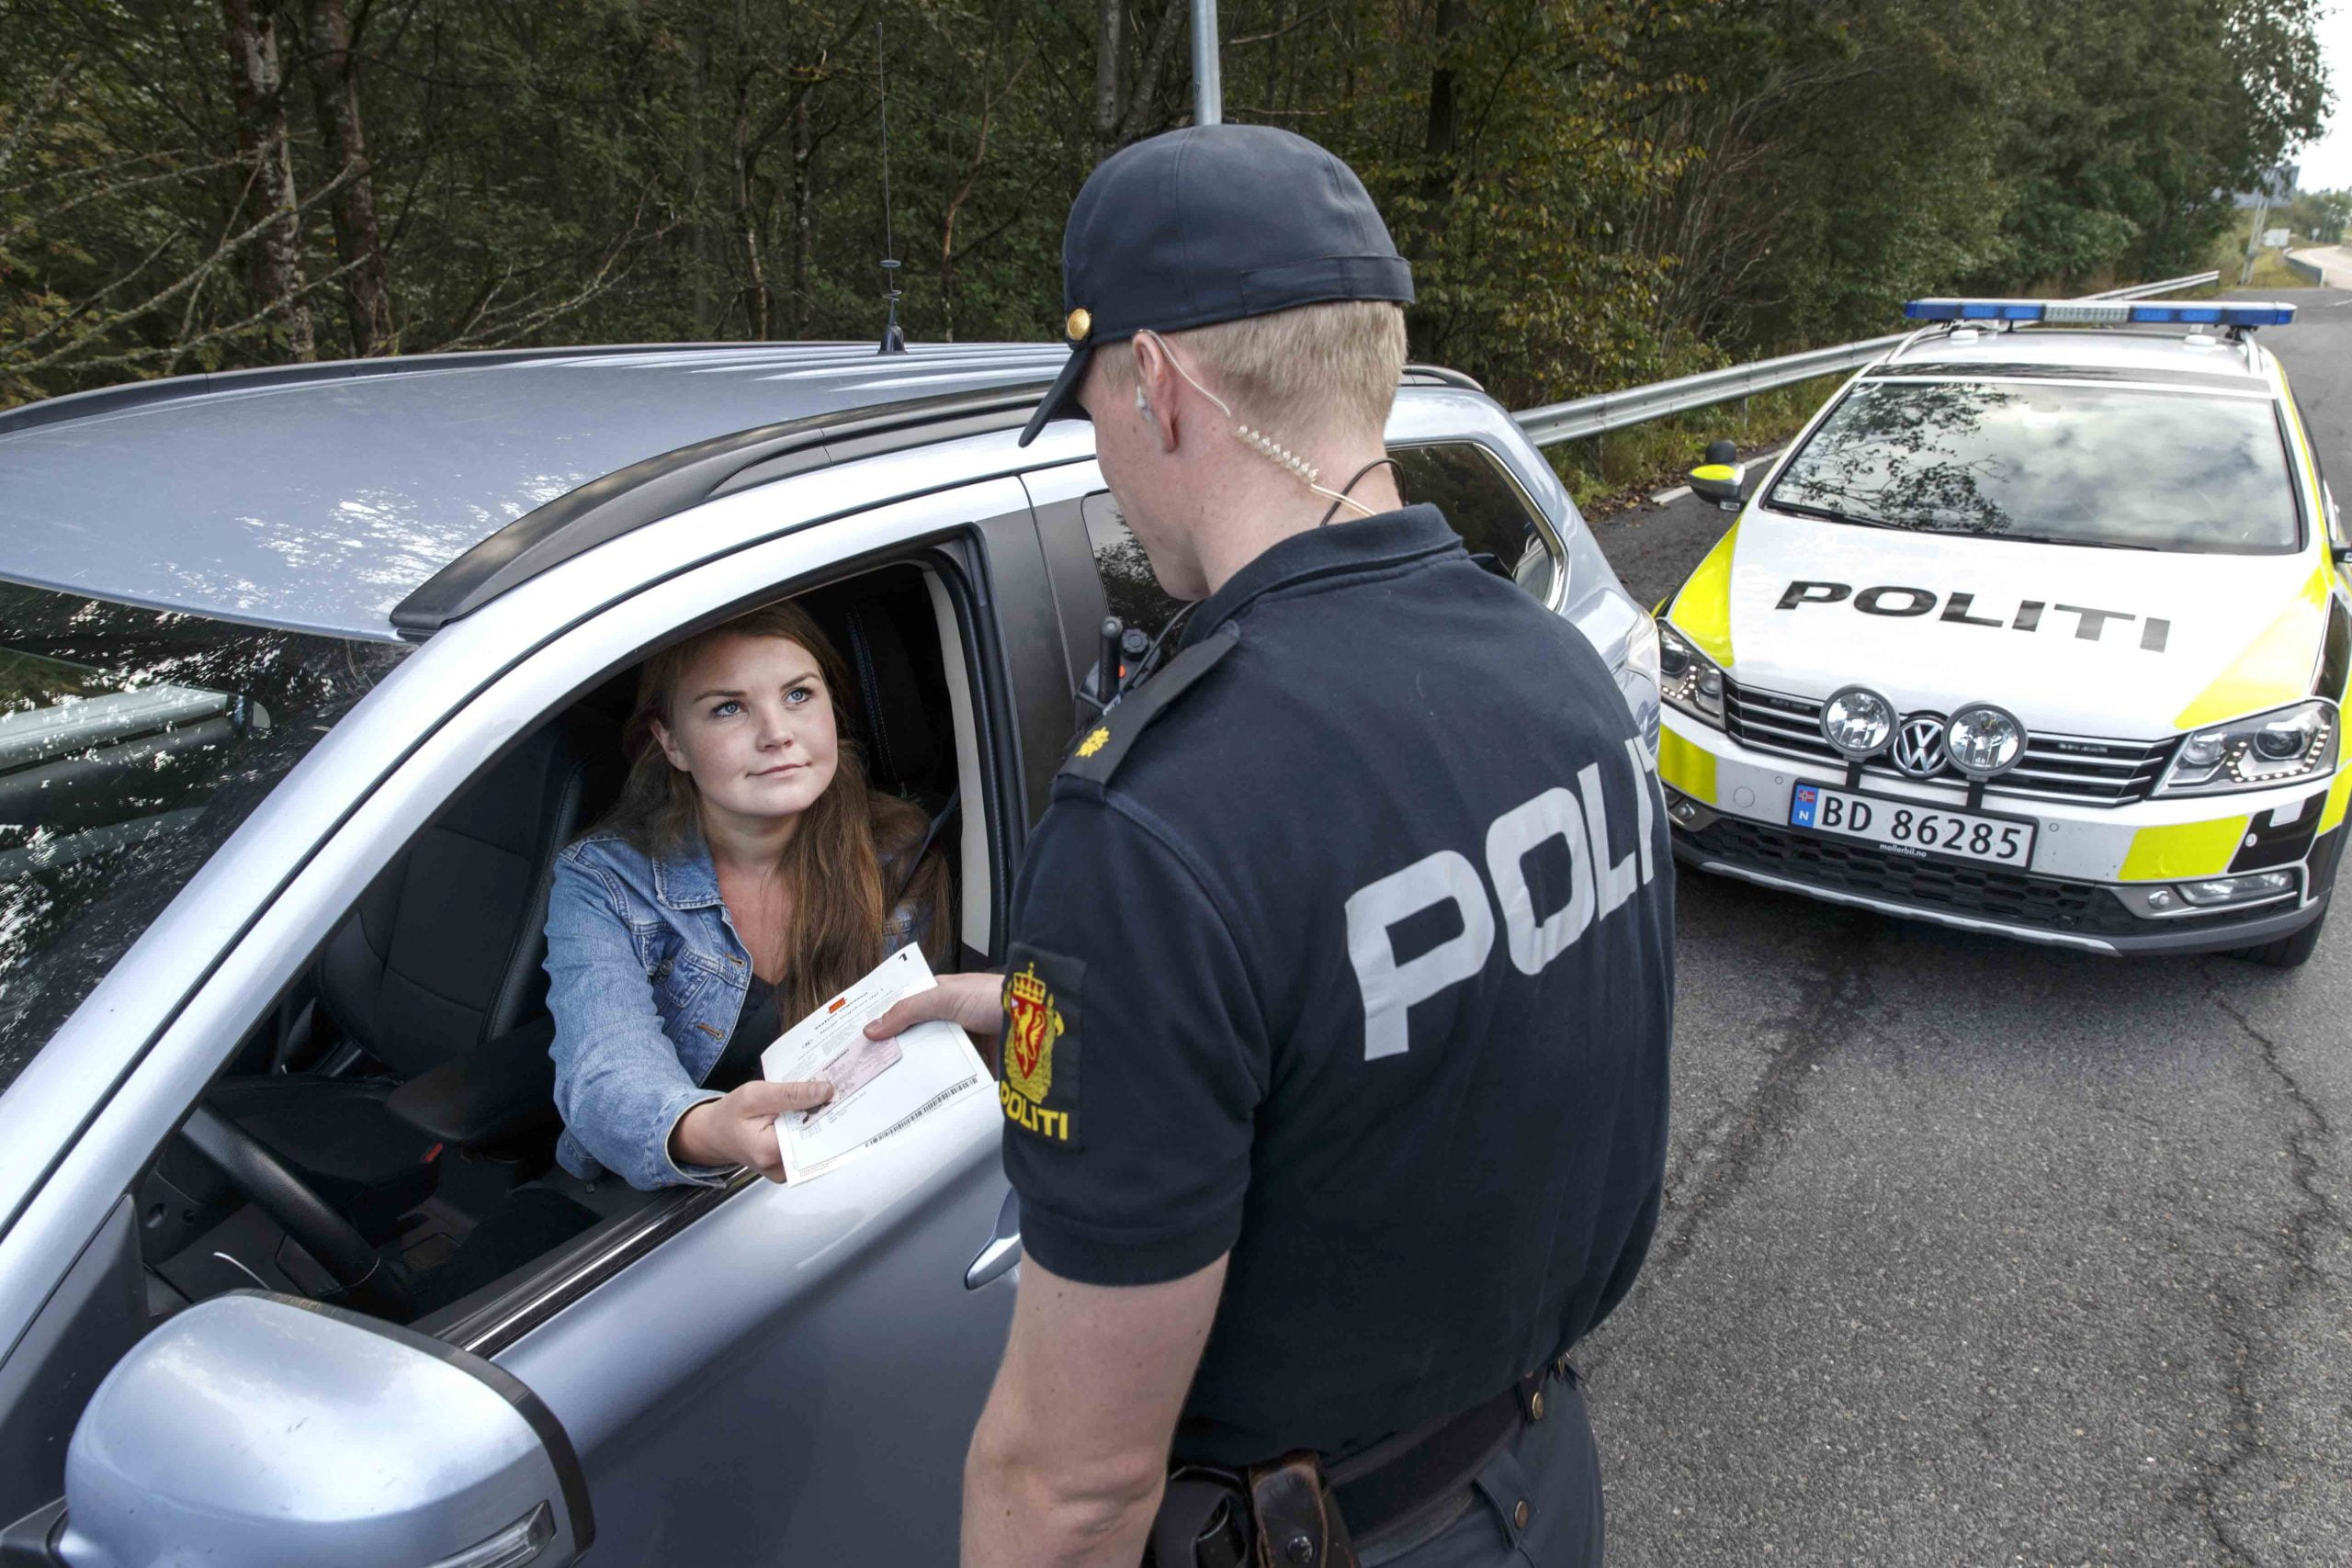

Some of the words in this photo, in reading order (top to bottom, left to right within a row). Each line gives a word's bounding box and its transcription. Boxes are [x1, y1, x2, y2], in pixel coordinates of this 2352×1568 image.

[1774, 581, 2171, 653] POLITI
[1798, 811, 1809, 820] N
[1822, 795, 1872, 832] BD
[1891, 809, 2021, 860] 86285
[1344, 735, 1656, 1061] POLI
[1000, 1079, 1069, 1142] POLITI
